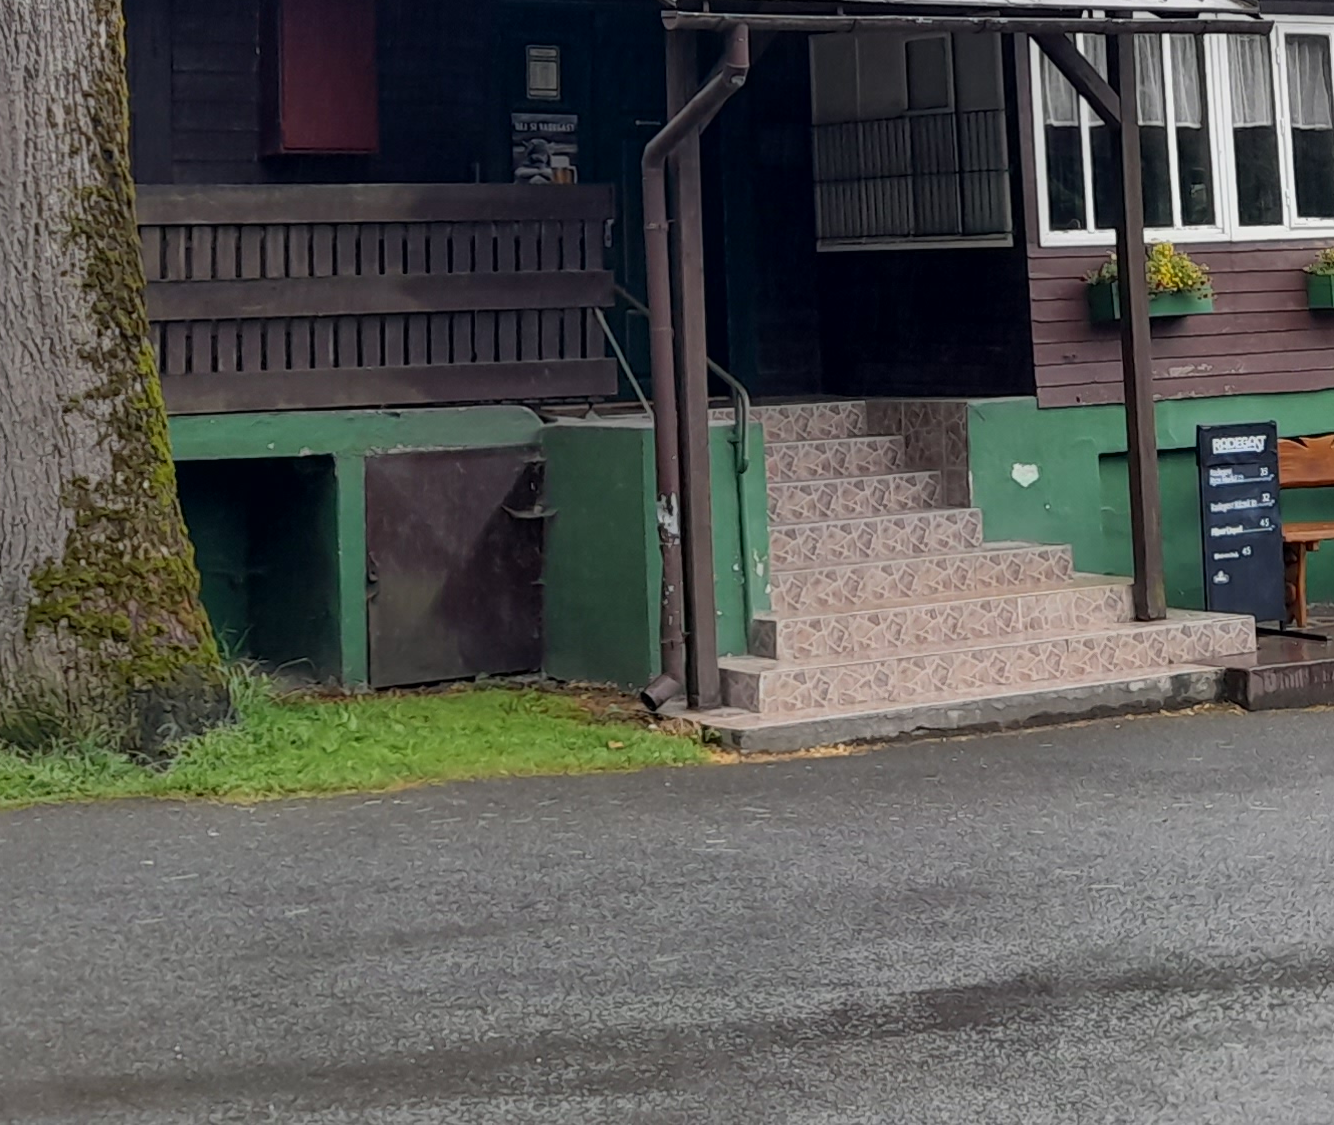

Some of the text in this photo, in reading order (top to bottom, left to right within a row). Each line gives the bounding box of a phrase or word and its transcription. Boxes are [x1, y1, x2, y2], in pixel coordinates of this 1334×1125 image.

[1212, 435, 1267, 454] RADEGAST
[1259, 517, 1270, 528] 45
[1241, 545, 1252, 556] 45
[594, 737, 611, 752] 139
